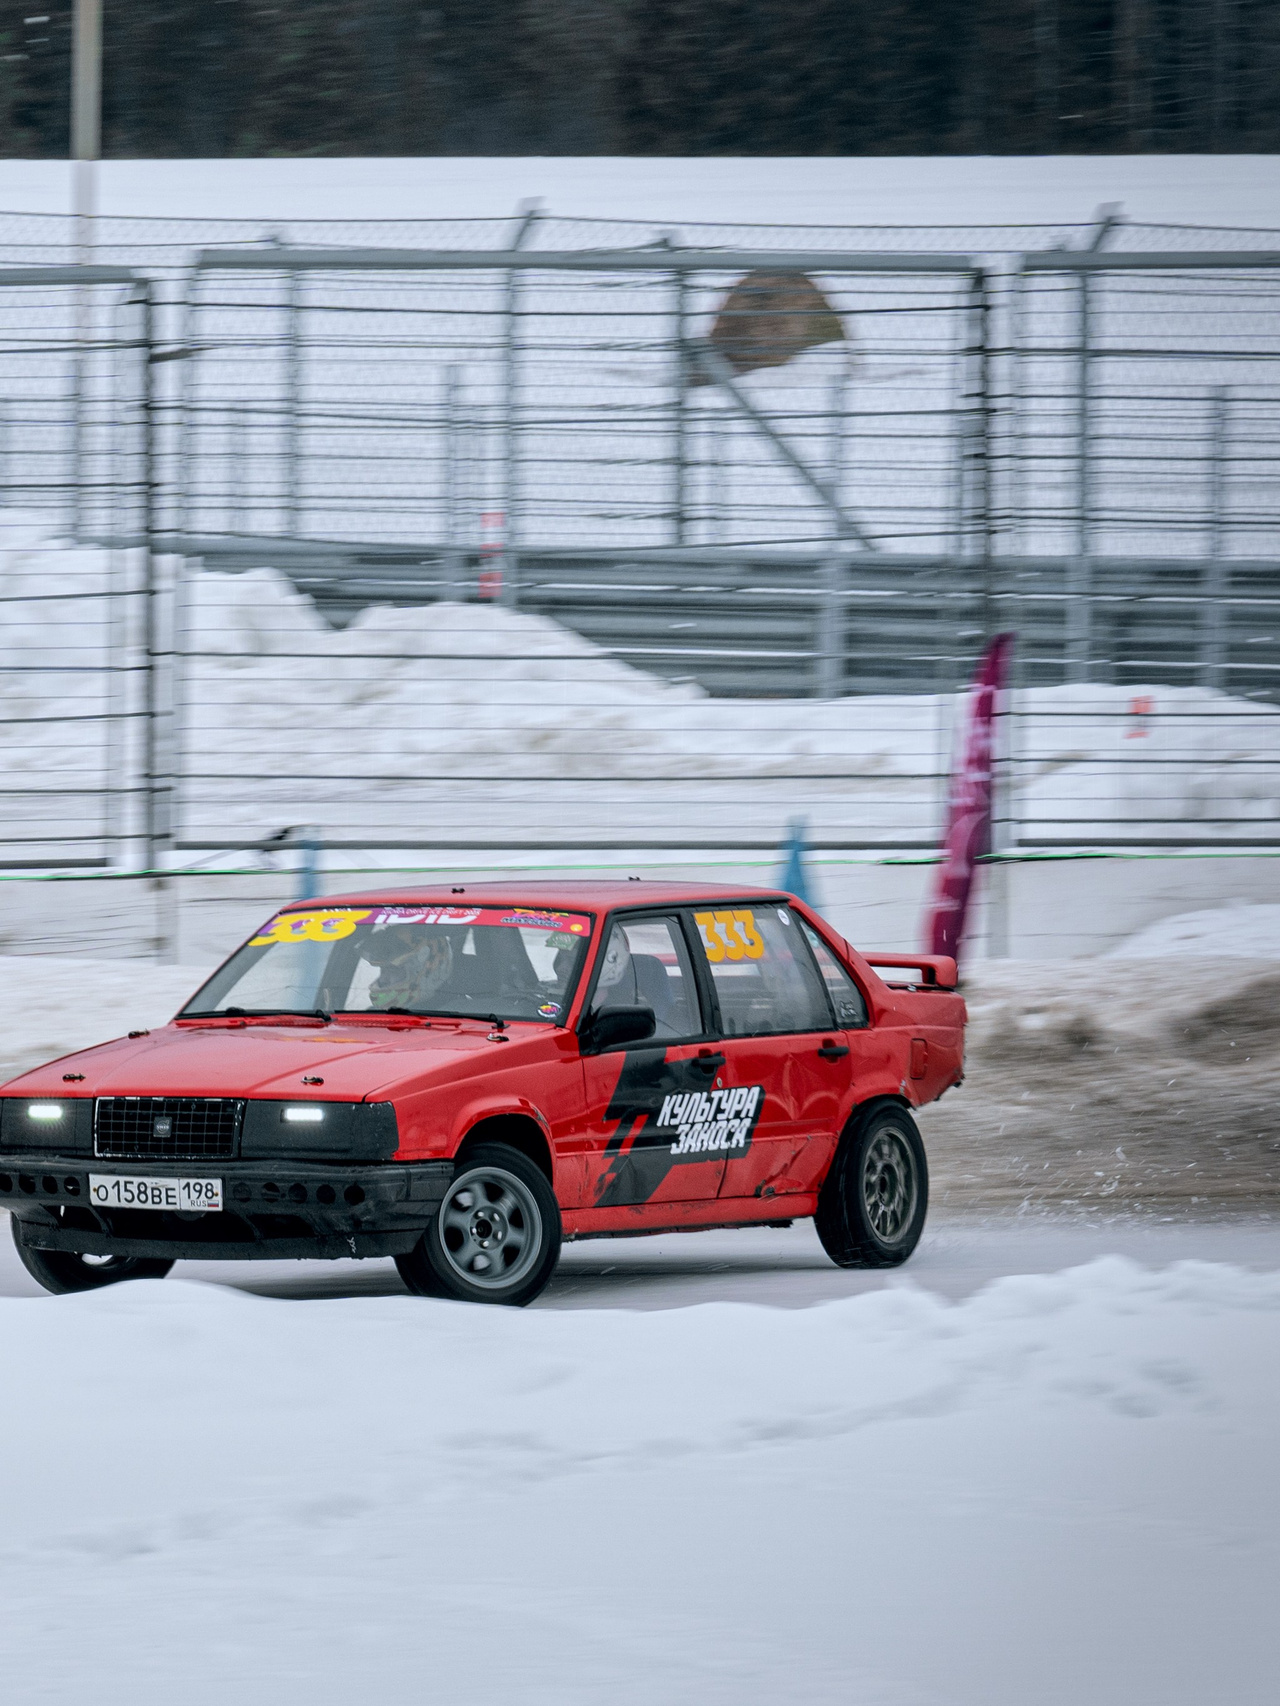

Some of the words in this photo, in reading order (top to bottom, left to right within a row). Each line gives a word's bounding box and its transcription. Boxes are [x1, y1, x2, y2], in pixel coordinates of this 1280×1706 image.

[248, 910, 373, 947] 333
[694, 909, 764, 962] 333
[656, 1086, 760, 1127] КУЛЬТУРА
[670, 1118, 752, 1154] ЗАНОСА
[182, 1182, 214, 1200] 198
